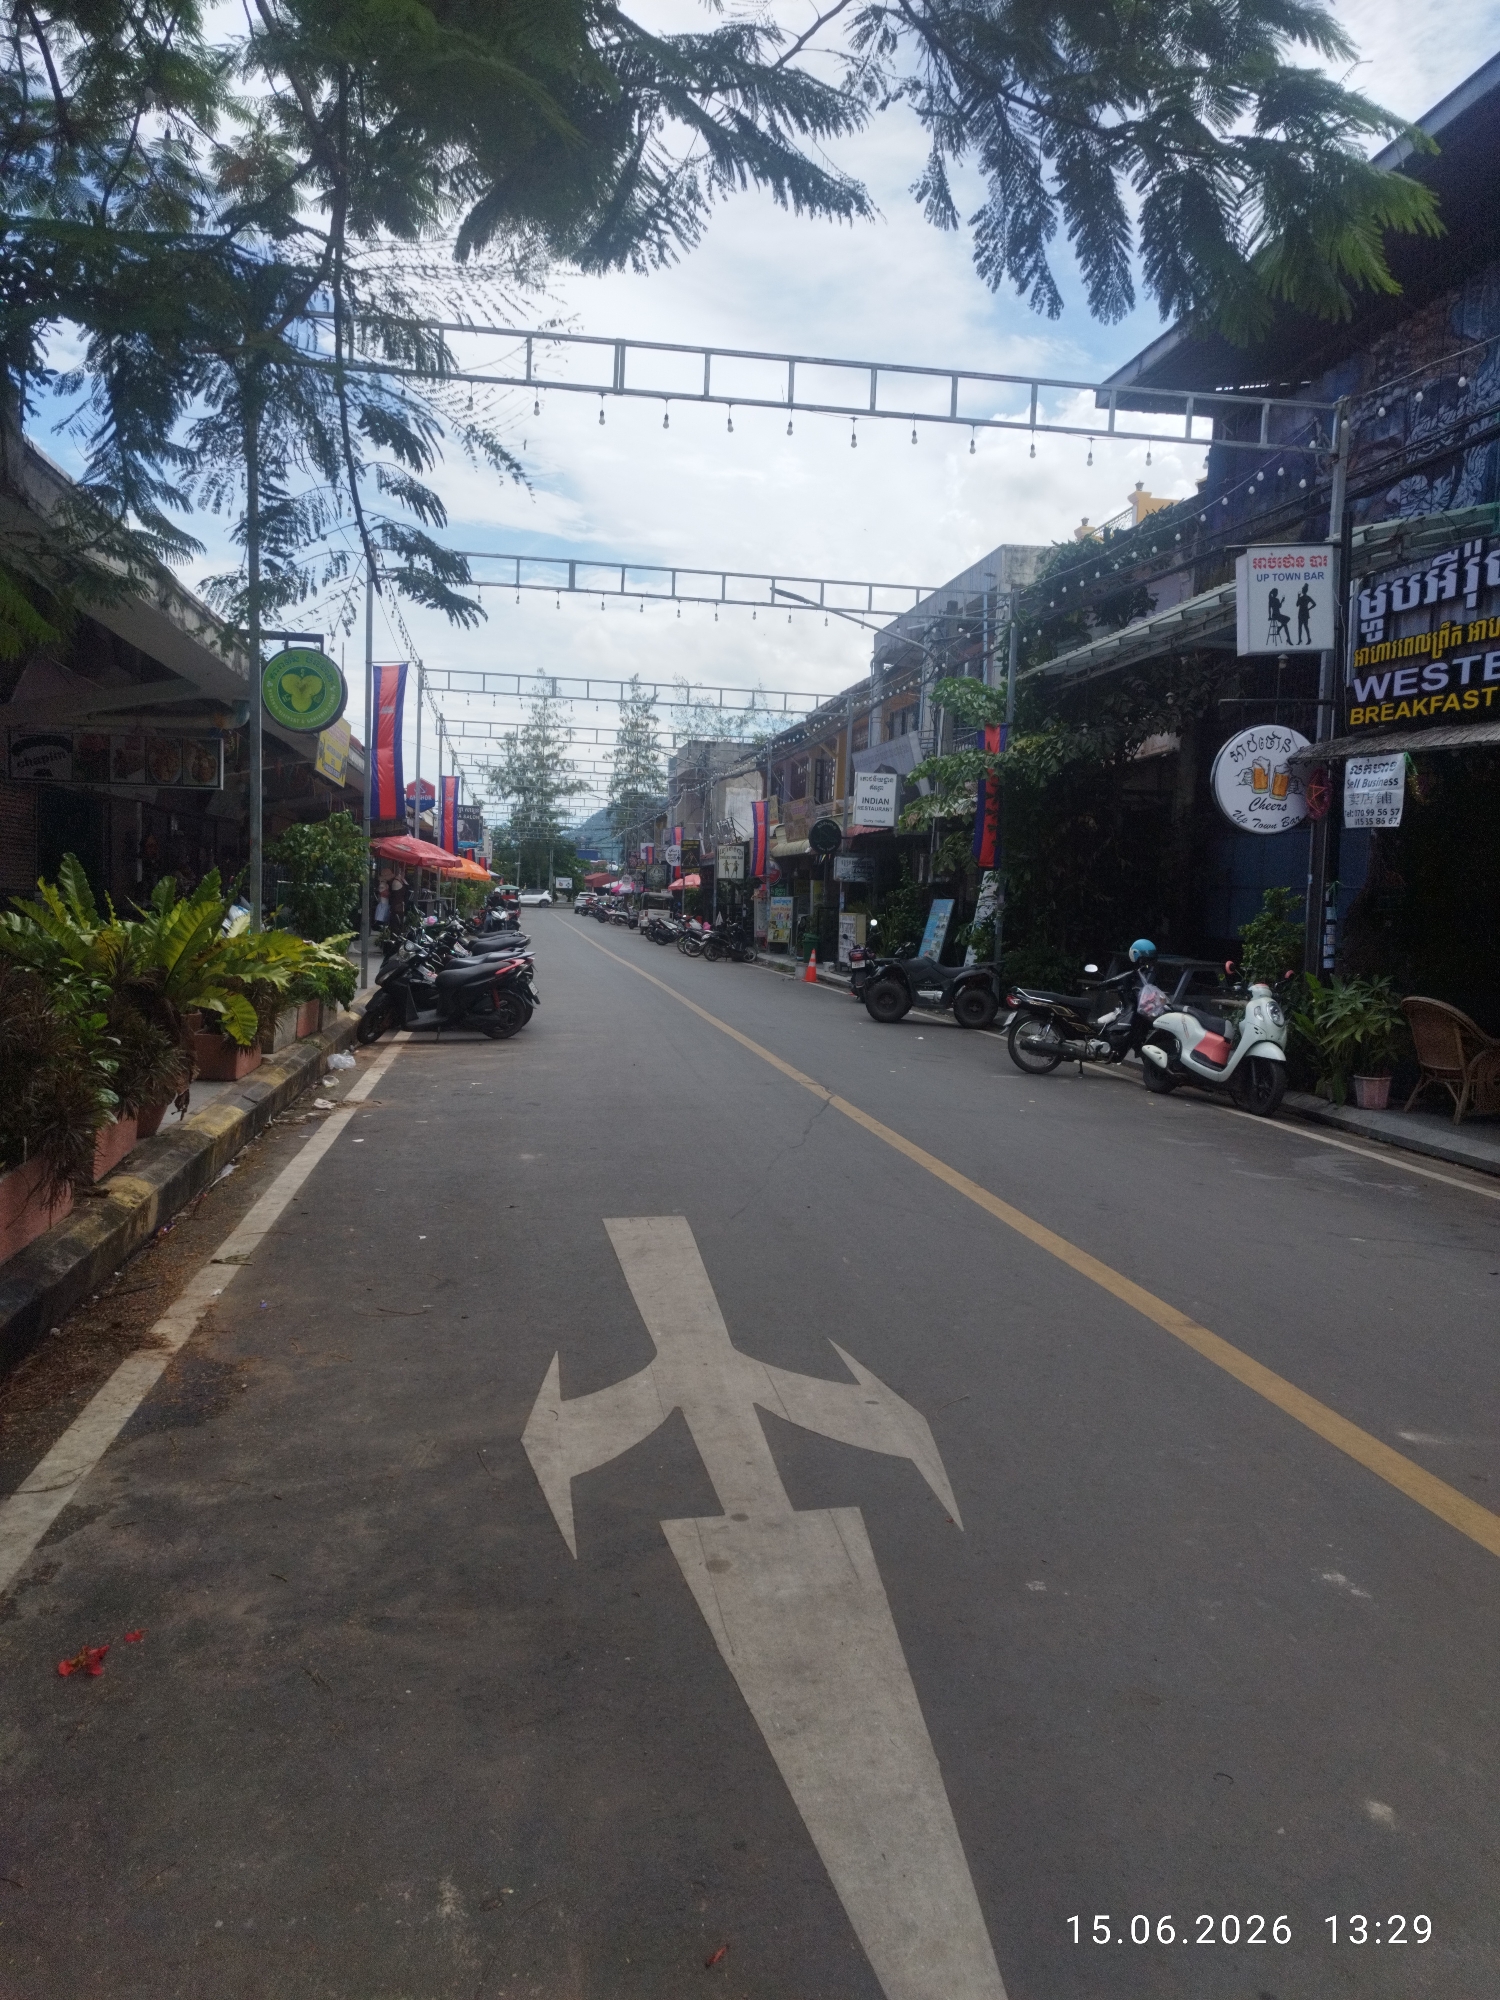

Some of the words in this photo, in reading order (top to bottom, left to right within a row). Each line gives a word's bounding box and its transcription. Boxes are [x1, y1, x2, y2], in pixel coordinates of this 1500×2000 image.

[1256, 573, 1270, 582] UP
[1272, 572, 1301, 582] TOWN
[1303, 571, 1325, 581] BAR
[1349, 686, 1499, 725] BREAKFAST
[1361, 776, 1399, 788] Business
[861, 796, 890, 806] INDIAN
[1248, 796, 1288, 812] Cheers
[857, 805, 893, 813] RESTAURANT
[1365, 808, 1375, 816] 99
[1377, 808, 1388, 816] 56
[1390, 808, 1400, 816] 57
[1232, 809, 1248, 824] Up
[1251, 818, 1278, 829] Town
[1281, 815, 1302, 828] Bar
